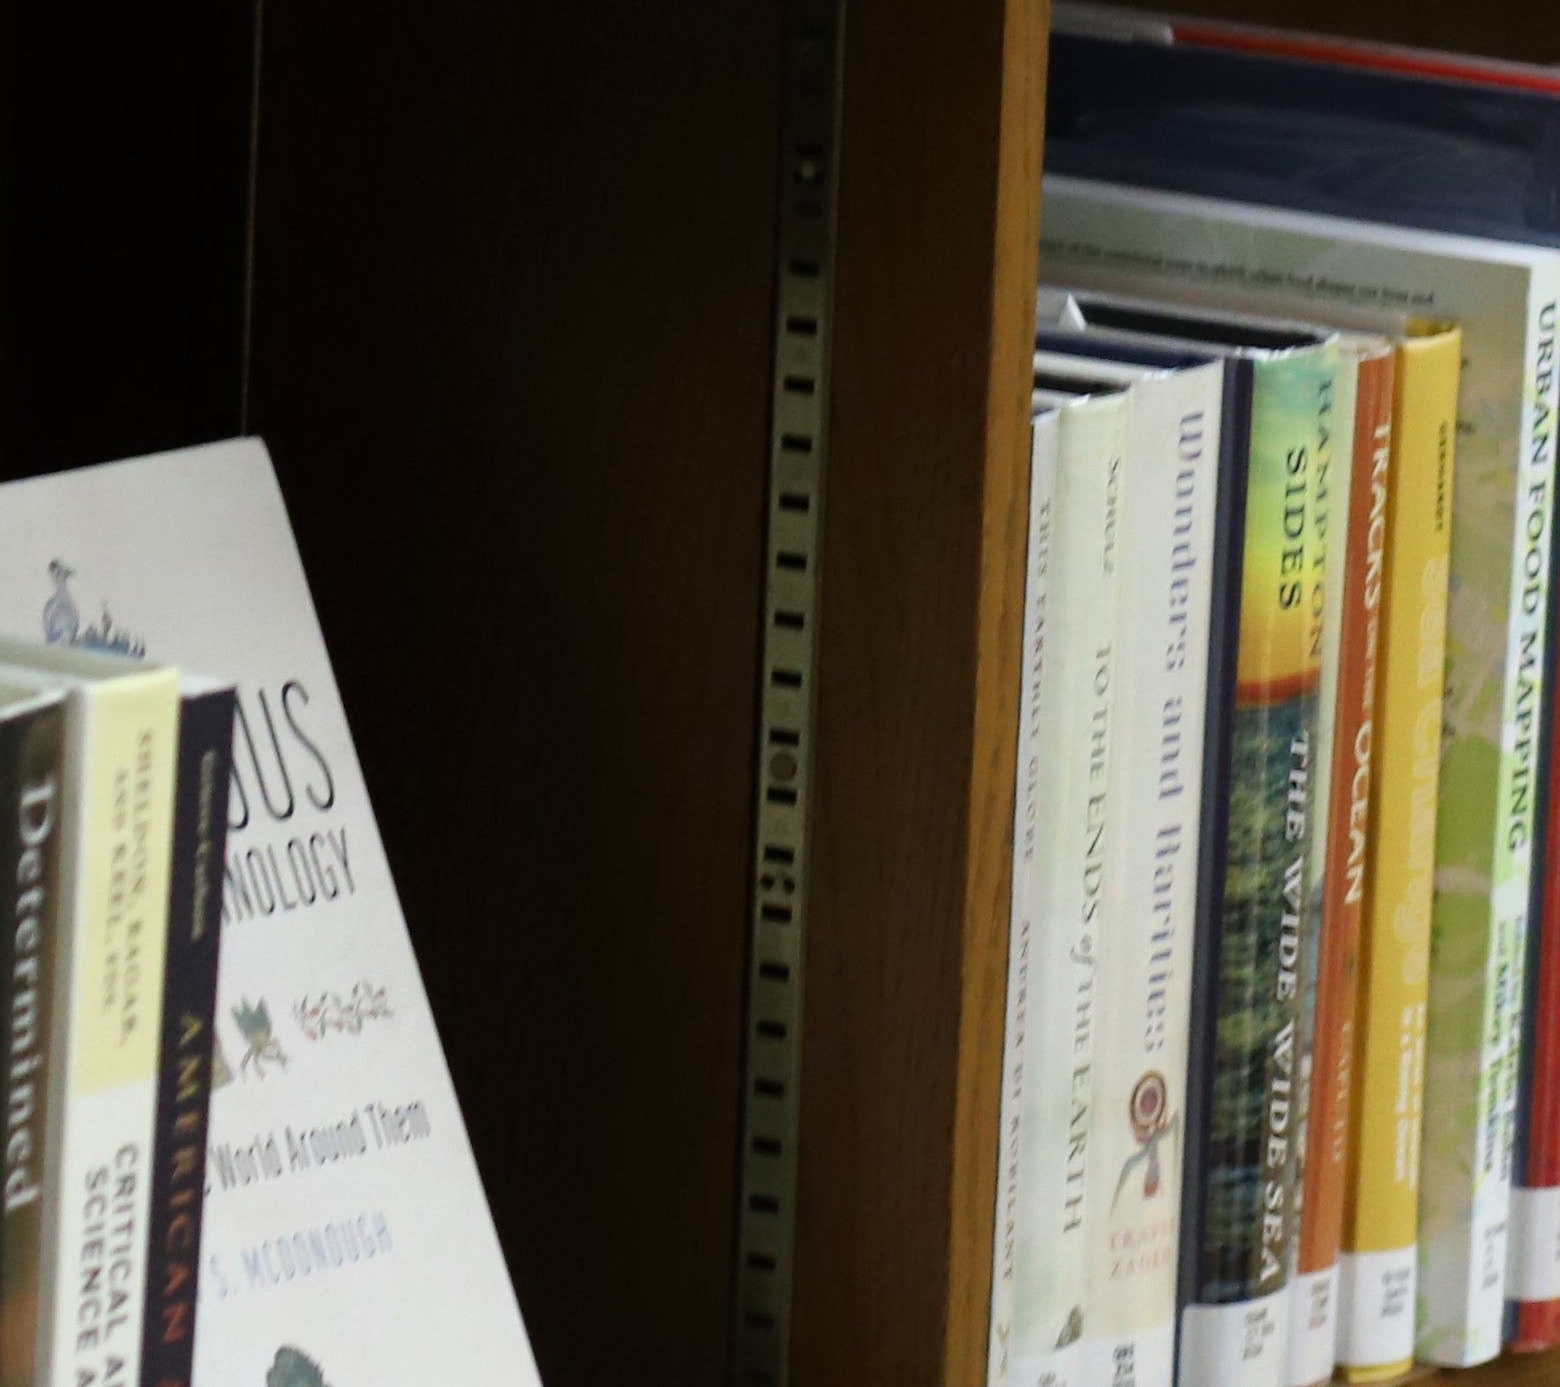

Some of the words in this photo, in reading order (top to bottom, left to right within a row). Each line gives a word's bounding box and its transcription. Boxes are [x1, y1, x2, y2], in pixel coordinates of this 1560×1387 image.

[1531, 302, 1556, 464] URBAN
[1165, 411, 1203, 672] Wonders
[1279, 446, 1307, 611] SIDES
[1309, 380, 1333, 658] HAMPTON
[1365, 424, 1392, 612] TRACKS
[1523, 482, 1546, 614] FOOD
[1087, 709, 1108, 783] THE
[1094, 646, 1111, 701] TO
[1509, 632, 1537, 852] MAPPING
[1158, 697, 1183, 801] and
[1285, 730, 1309, 842] THE
[1345, 719, 1371, 904] OCEAN
[222, 827, 356, 924] NOLOGY
[1081, 793, 1107, 924] ENDS
[1276, 854, 1306, 1003] WIDE
[3, 781, 57, 1215] Determined
[1072, 932, 1095, 974] of
[1145, 825, 1181, 1052] Rarities
[1073, 978, 1094, 1052] THE
[213, 1138, 281, 1190] World
[285, 1118, 365, 1176] Around
[363, 1099, 430, 1149] Them
[1062, 1063, 1092, 1234] EARTH
[1267, 1019, 1294, 1167] WIDE
[107, 1142, 140, 1336] CRITICAL
[161, 1015, 202, 1346] AMERICAN
[1260, 1181, 1285, 1282] SEA
[75, 1168, 109, 1350] SCIENCE
[104, 1354, 131, 1387] A
